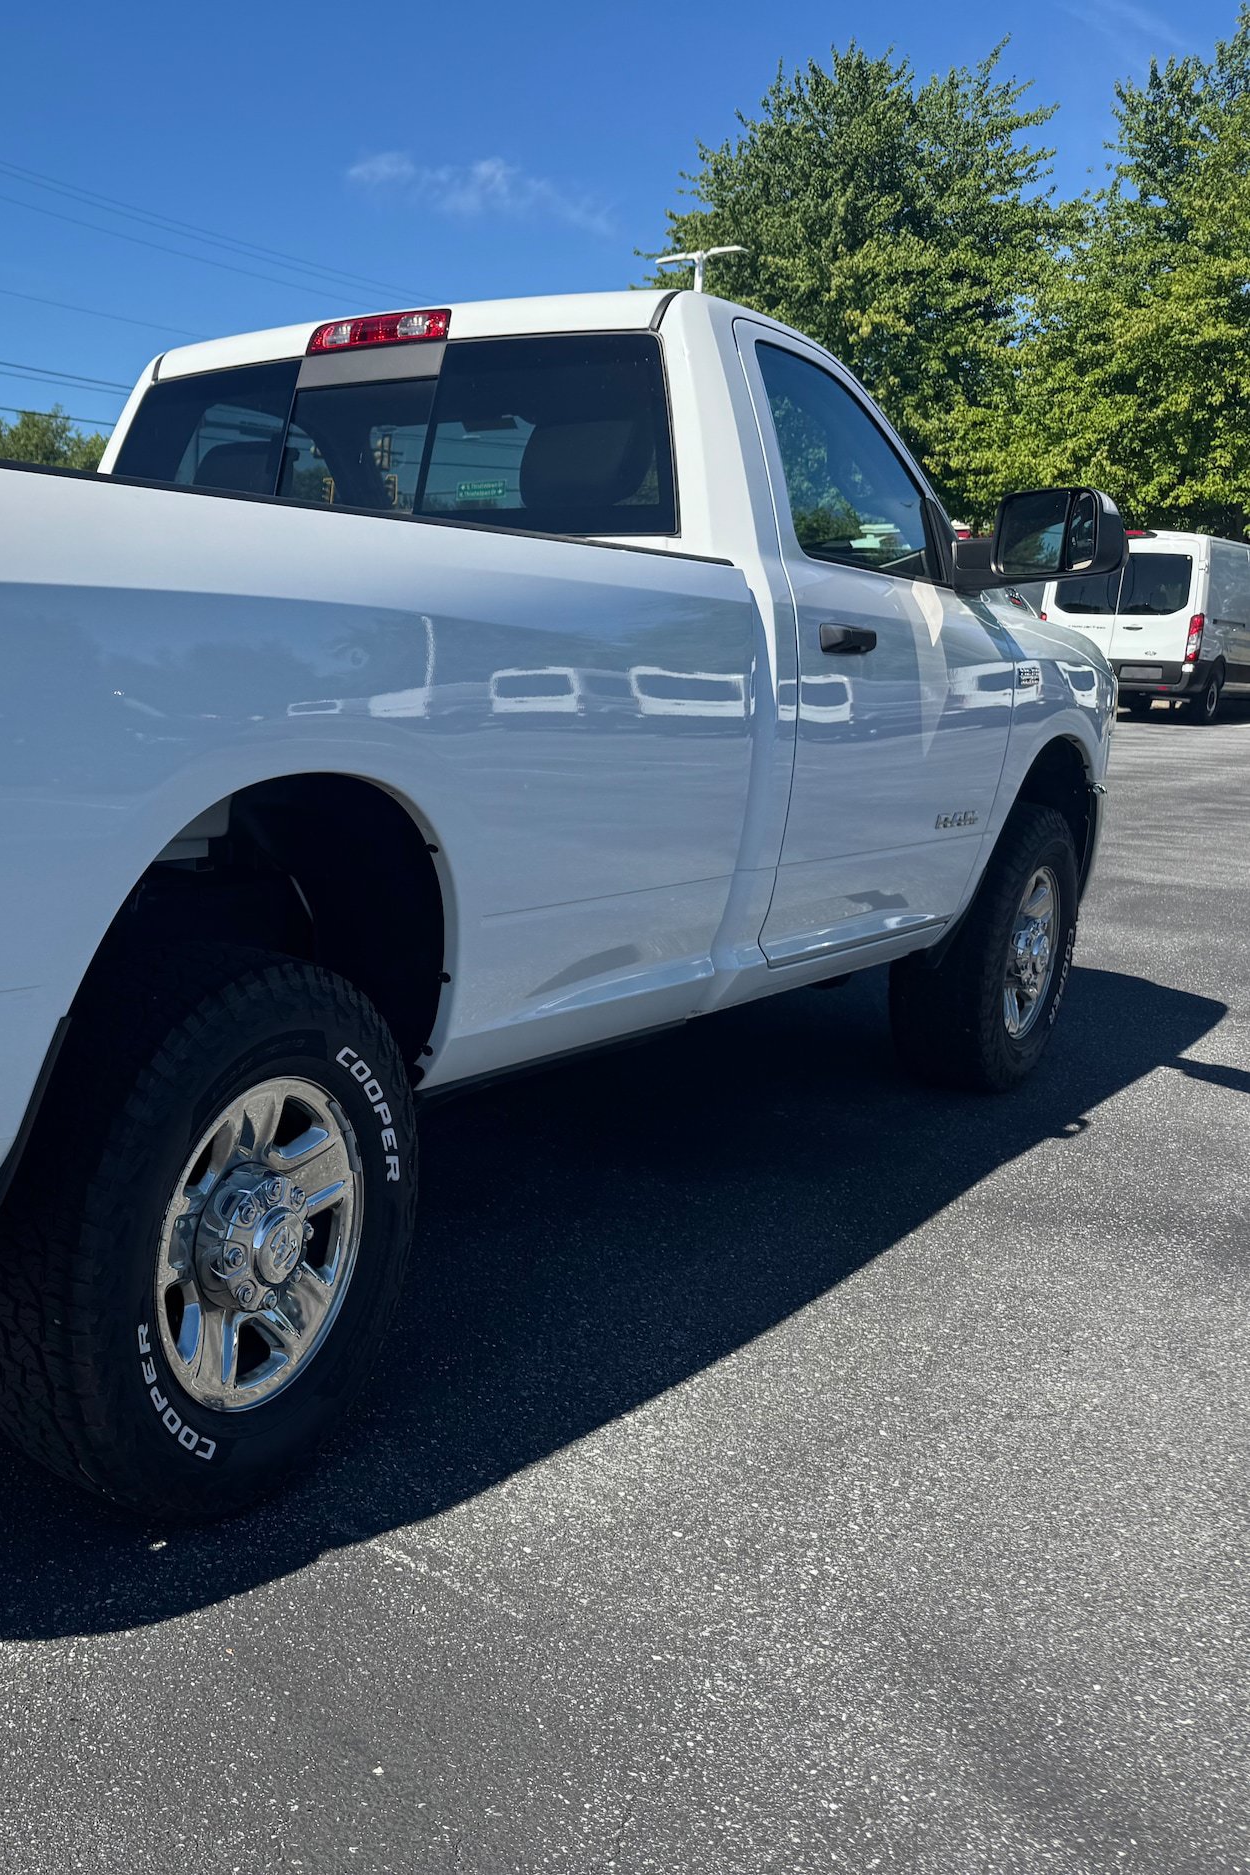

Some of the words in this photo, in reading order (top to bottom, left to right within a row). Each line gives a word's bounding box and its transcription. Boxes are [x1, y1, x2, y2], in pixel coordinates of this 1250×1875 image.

[934, 810, 978, 830] RAM
[335, 1046, 401, 1183] COOPER
[137, 1322, 217, 1460] COOPER
